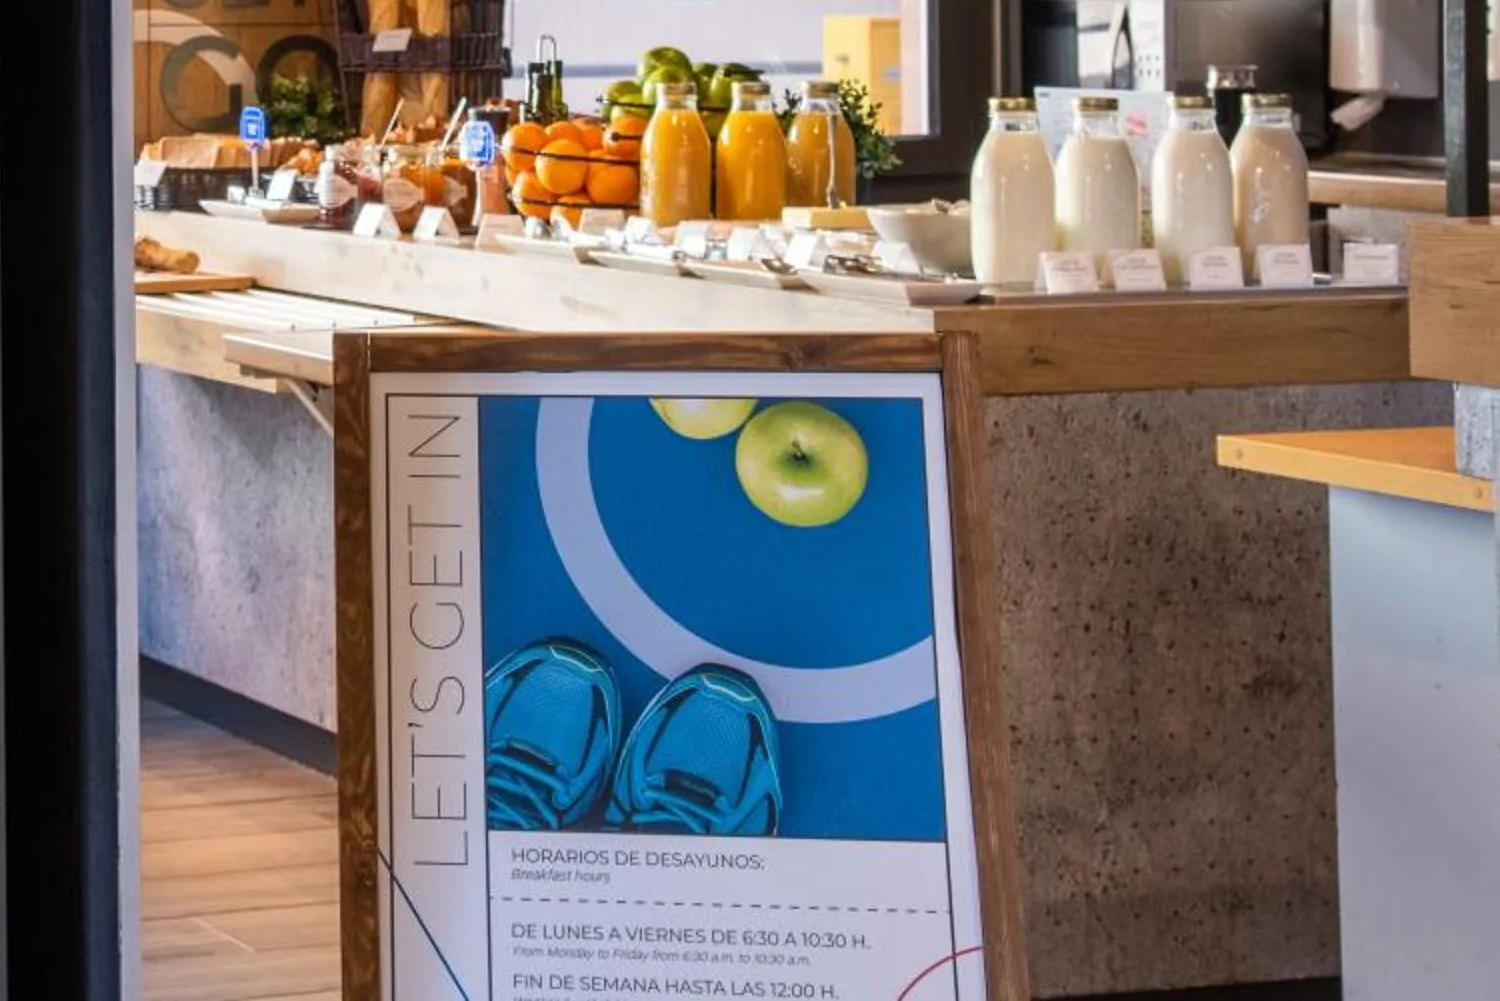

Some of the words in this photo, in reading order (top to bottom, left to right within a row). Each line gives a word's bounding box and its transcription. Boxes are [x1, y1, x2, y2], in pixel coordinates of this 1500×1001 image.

[407, 414, 462, 480] IN
[408, 502, 466, 651] GET
[410, 674, 470, 867] LET'S
[512, 849, 610, 866] HORARIOS
[614, 851, 641, 866] DE
[511, 868, 572, 882] Breakfast
[573, 869, 611, 884] hours
[511, 923, 538, 939] DE
[543, 925, 604, 941] LUNES
[609, 928, 621, 941] A
[625, 927, 707, 945] VIERNES
[711, 930, 738, 945] DE
[742, 930, 780, 947] 6:30
[784, 932, 797, 946] A
[801, 932, 847, 949] 10:30
[512, 946, 545, 958] From
[547, 947, 595, 961] Monday
[598, 949, 609, 959] to
[612, 948, 650, 962] Friday
[652, 949, 680, 962] from
[739, 953, 751, 964] to
[512, 973, 543, 989] FIN
[548, 974, 575, 990] DE
[579, 976, 661, 994] SEMANA
[664, 978, 726, 996] HASTA
[731, 981, 767, 997] LAS
[770, 983, 816, 999] 12:00
